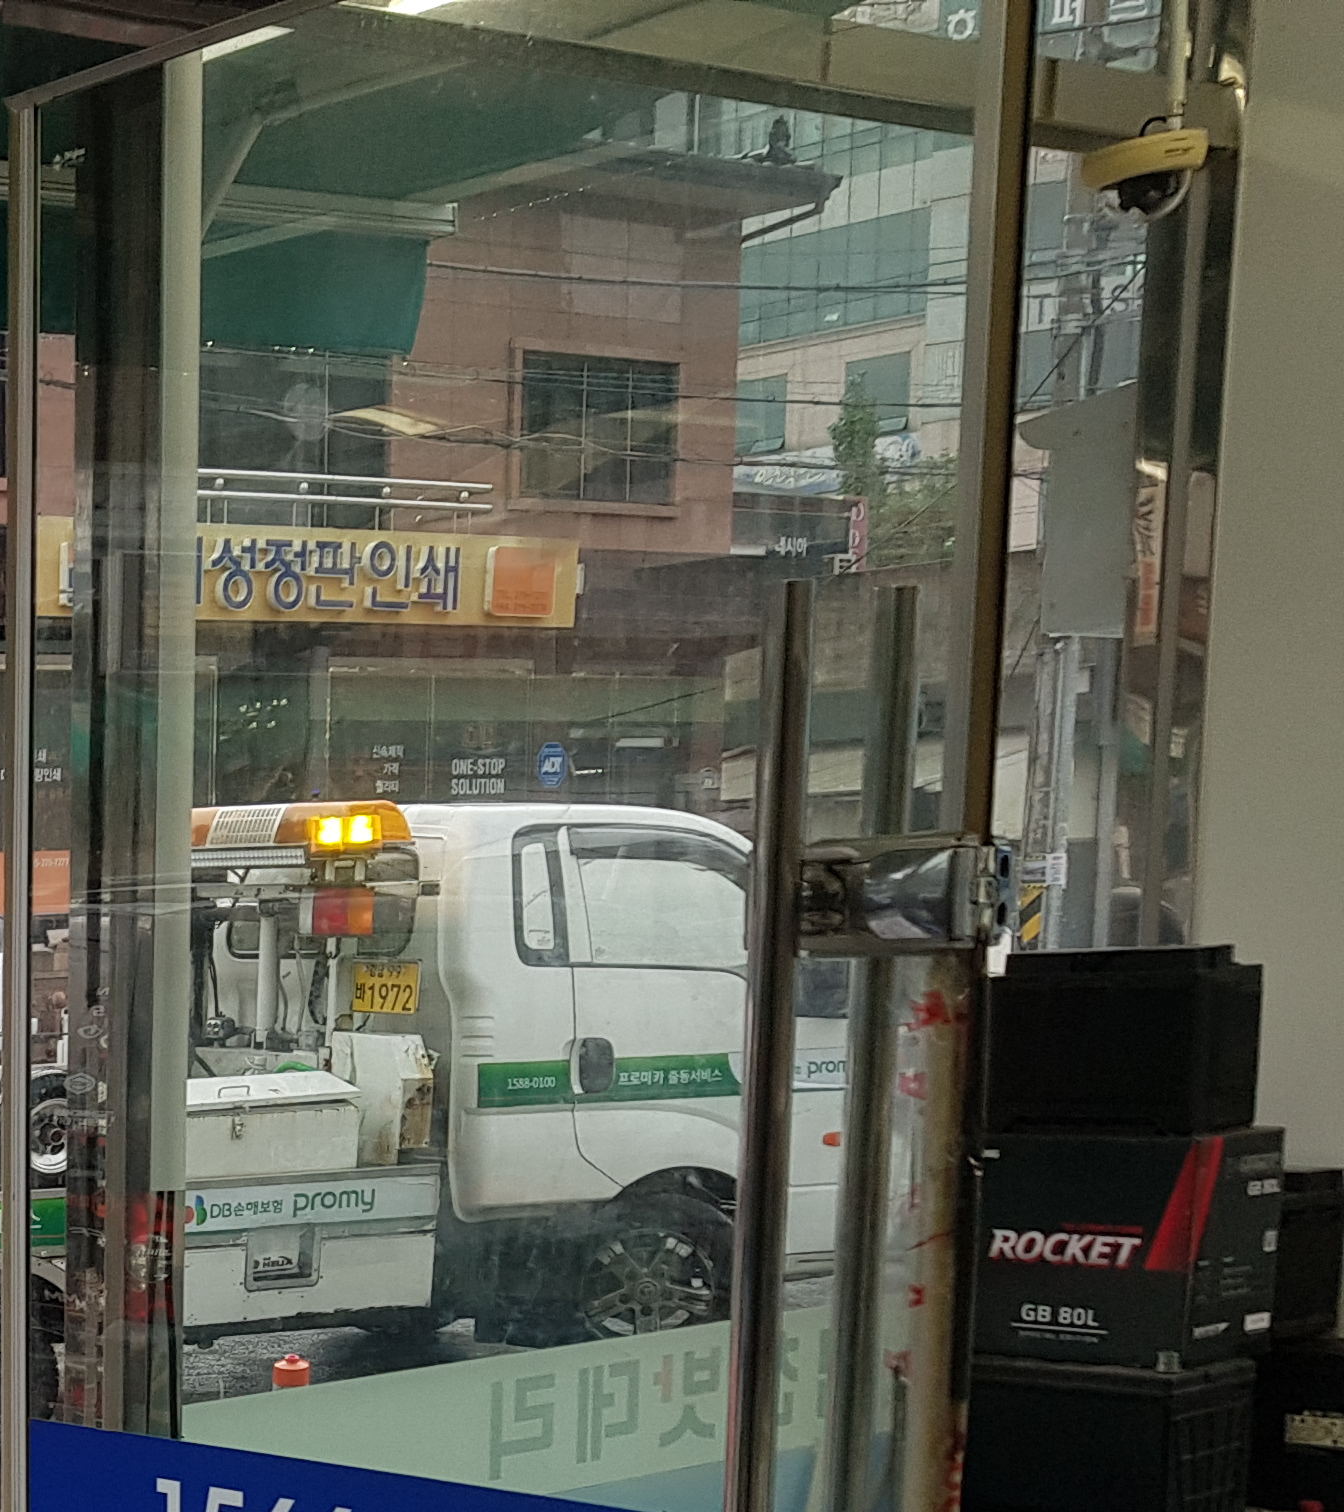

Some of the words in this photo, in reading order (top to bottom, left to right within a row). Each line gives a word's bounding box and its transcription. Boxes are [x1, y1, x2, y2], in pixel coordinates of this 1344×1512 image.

[196, 534, 462, 612] 성정판인쇄
[451, 758, 507, 776] ONE-STOP
[450, 777, 506, 796] SOLUTION
[618, 1068, 664, 1086] 프로미카
[668, 1067, 723, 1085] 출동서비스
[806, 1059, 846, 1079] prom
[506, 1075, 557, 1091] 1588-0100
[209, 1199, 284, 1220] DB손해보험
[292, 1188, 376, 1218] promy
[987, 1228, 1143, 1268] ROCKET
[1020, 1302, 1051, 1323] GB
[1056, 1305, 1100, 1328] 80L
